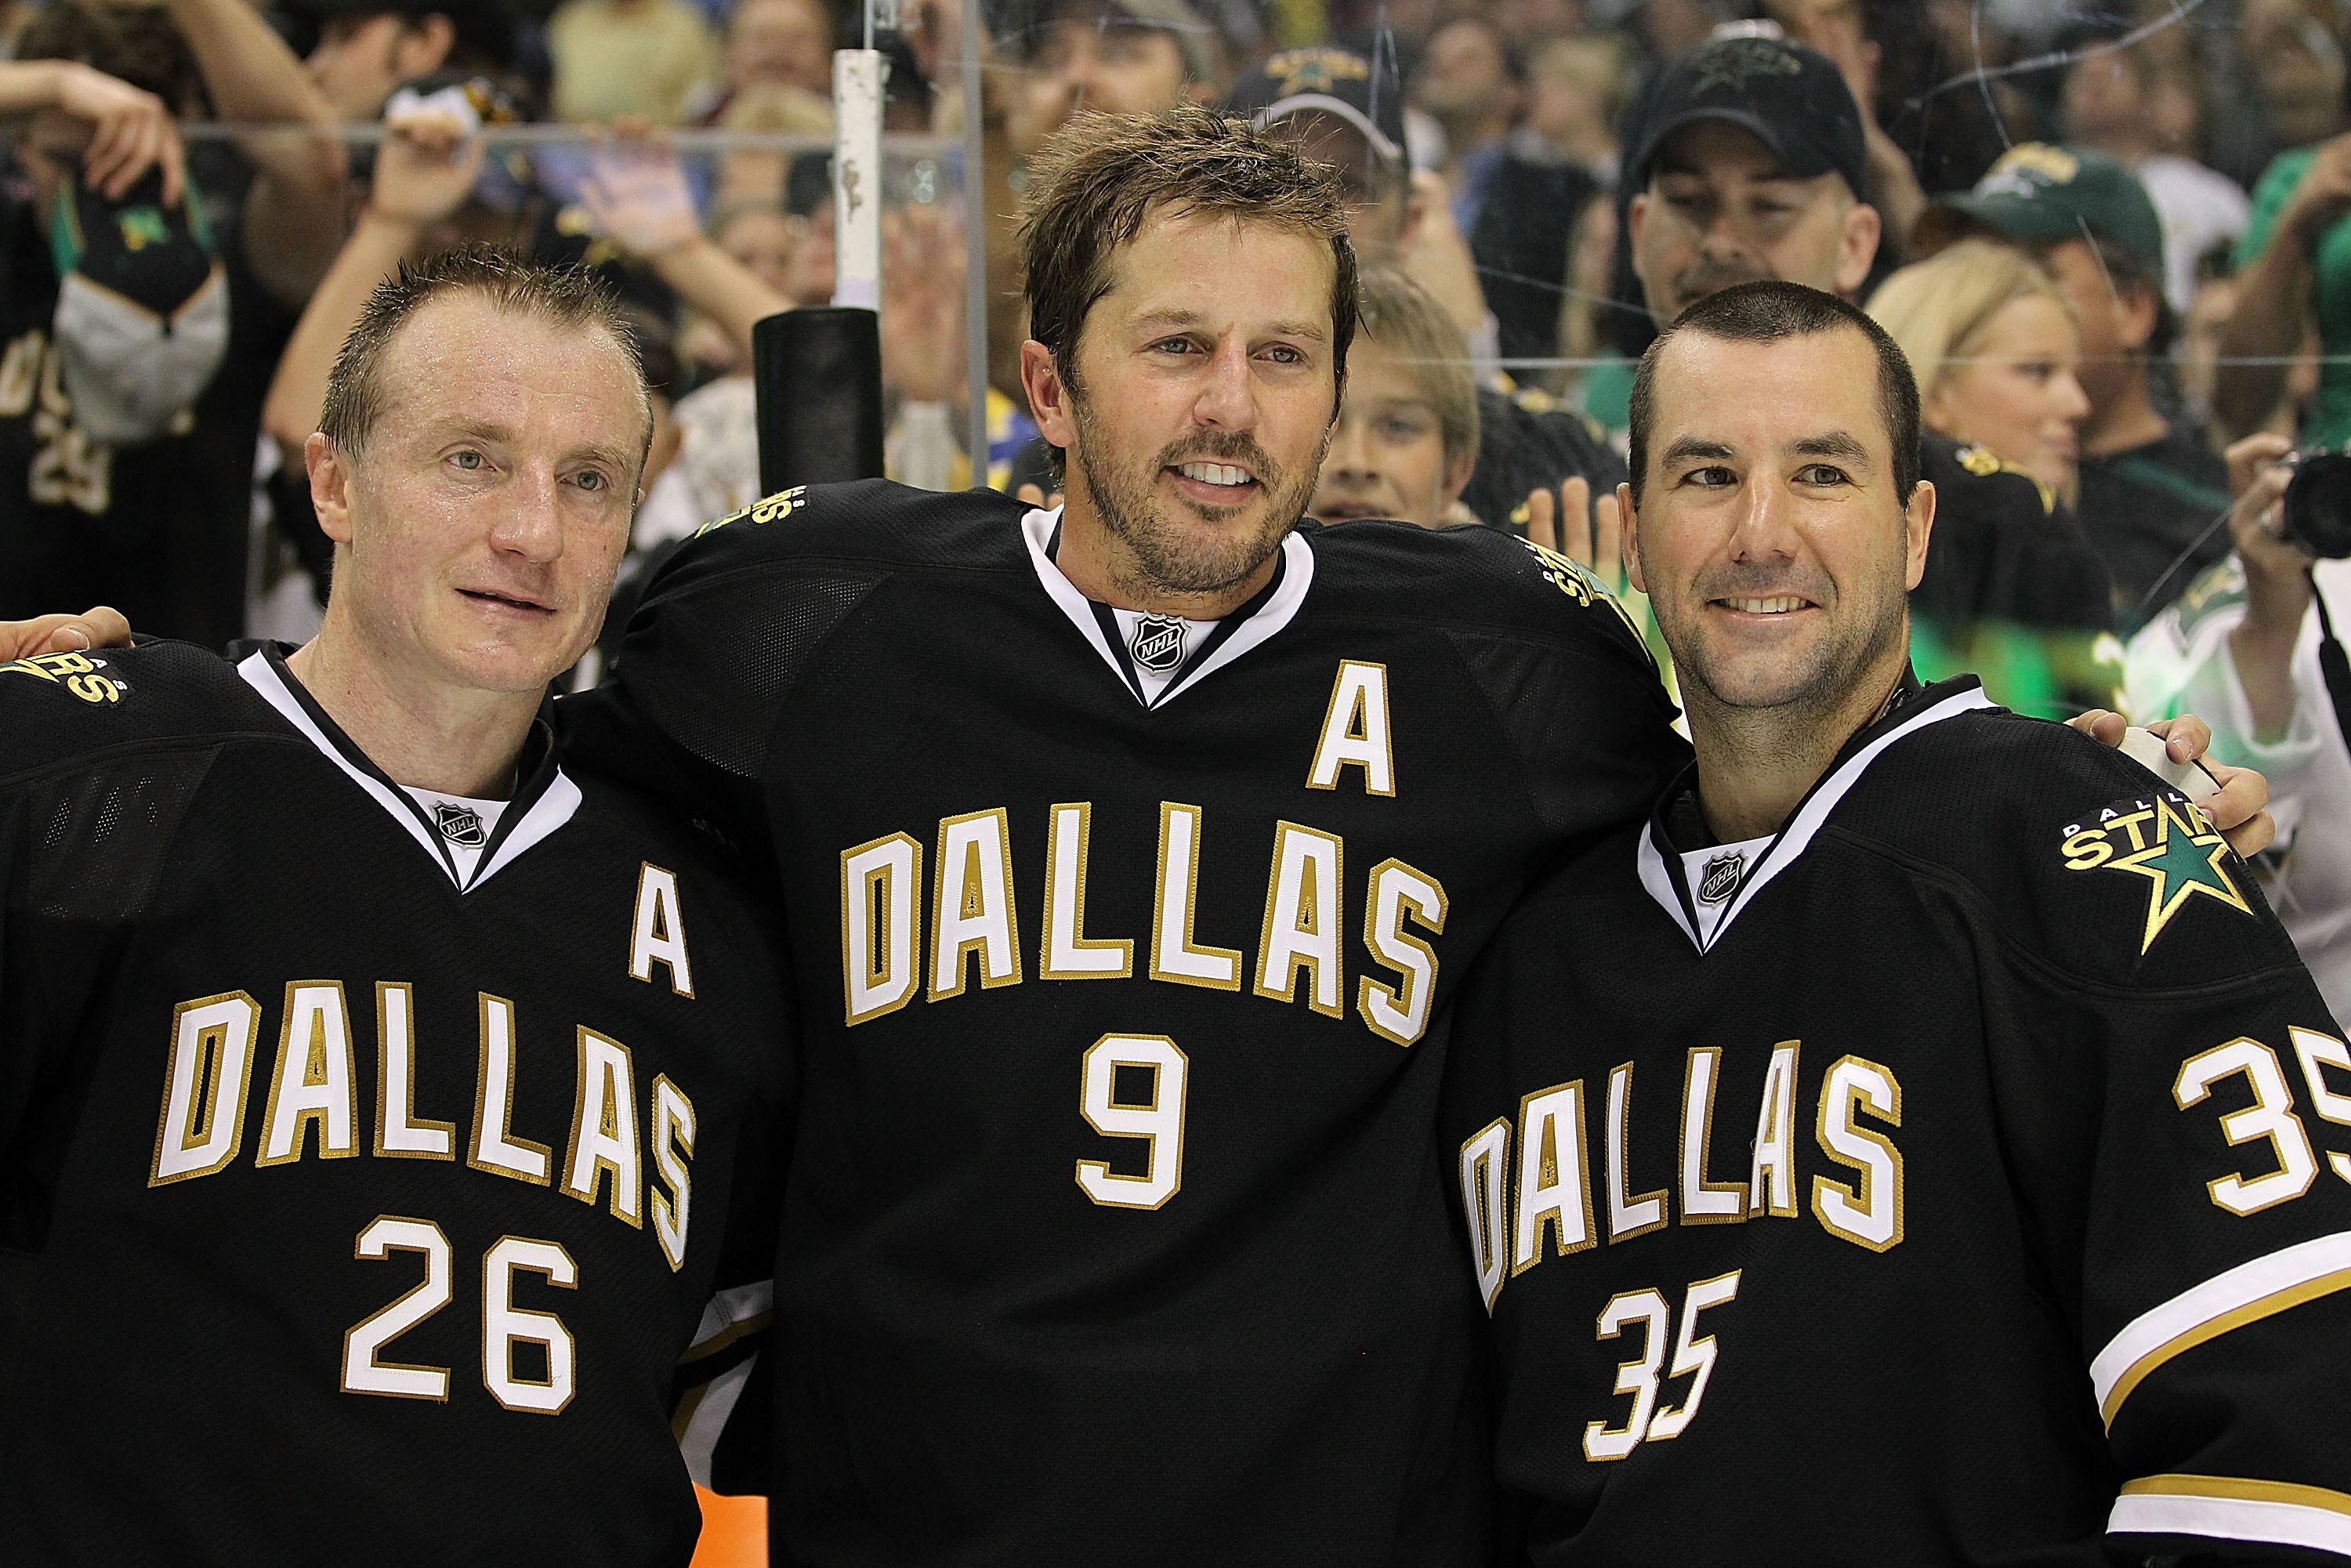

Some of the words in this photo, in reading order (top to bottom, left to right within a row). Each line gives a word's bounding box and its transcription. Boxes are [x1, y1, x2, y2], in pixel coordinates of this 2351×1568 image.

[1142, 631, 1177, 659] NHL
[1306, 659, 1396, 798] A
[445, 817, 476, 836] NHL
[1706, 864, 1737, 896] NHL
[2062, 792, 2184, 838] DALL
[629, 861, 695, 1000] A
[840, 801, 1449, 1047] DALLAS
[147, 980, 697, 1273] DALLAS
[1075, 1033, 1189, 1210] 9
[1459, 1040, 1904, 1320] DALLAS
[340, 1215, 578, 1415] 26
[1582, 1269, 1742, 1461] 35
